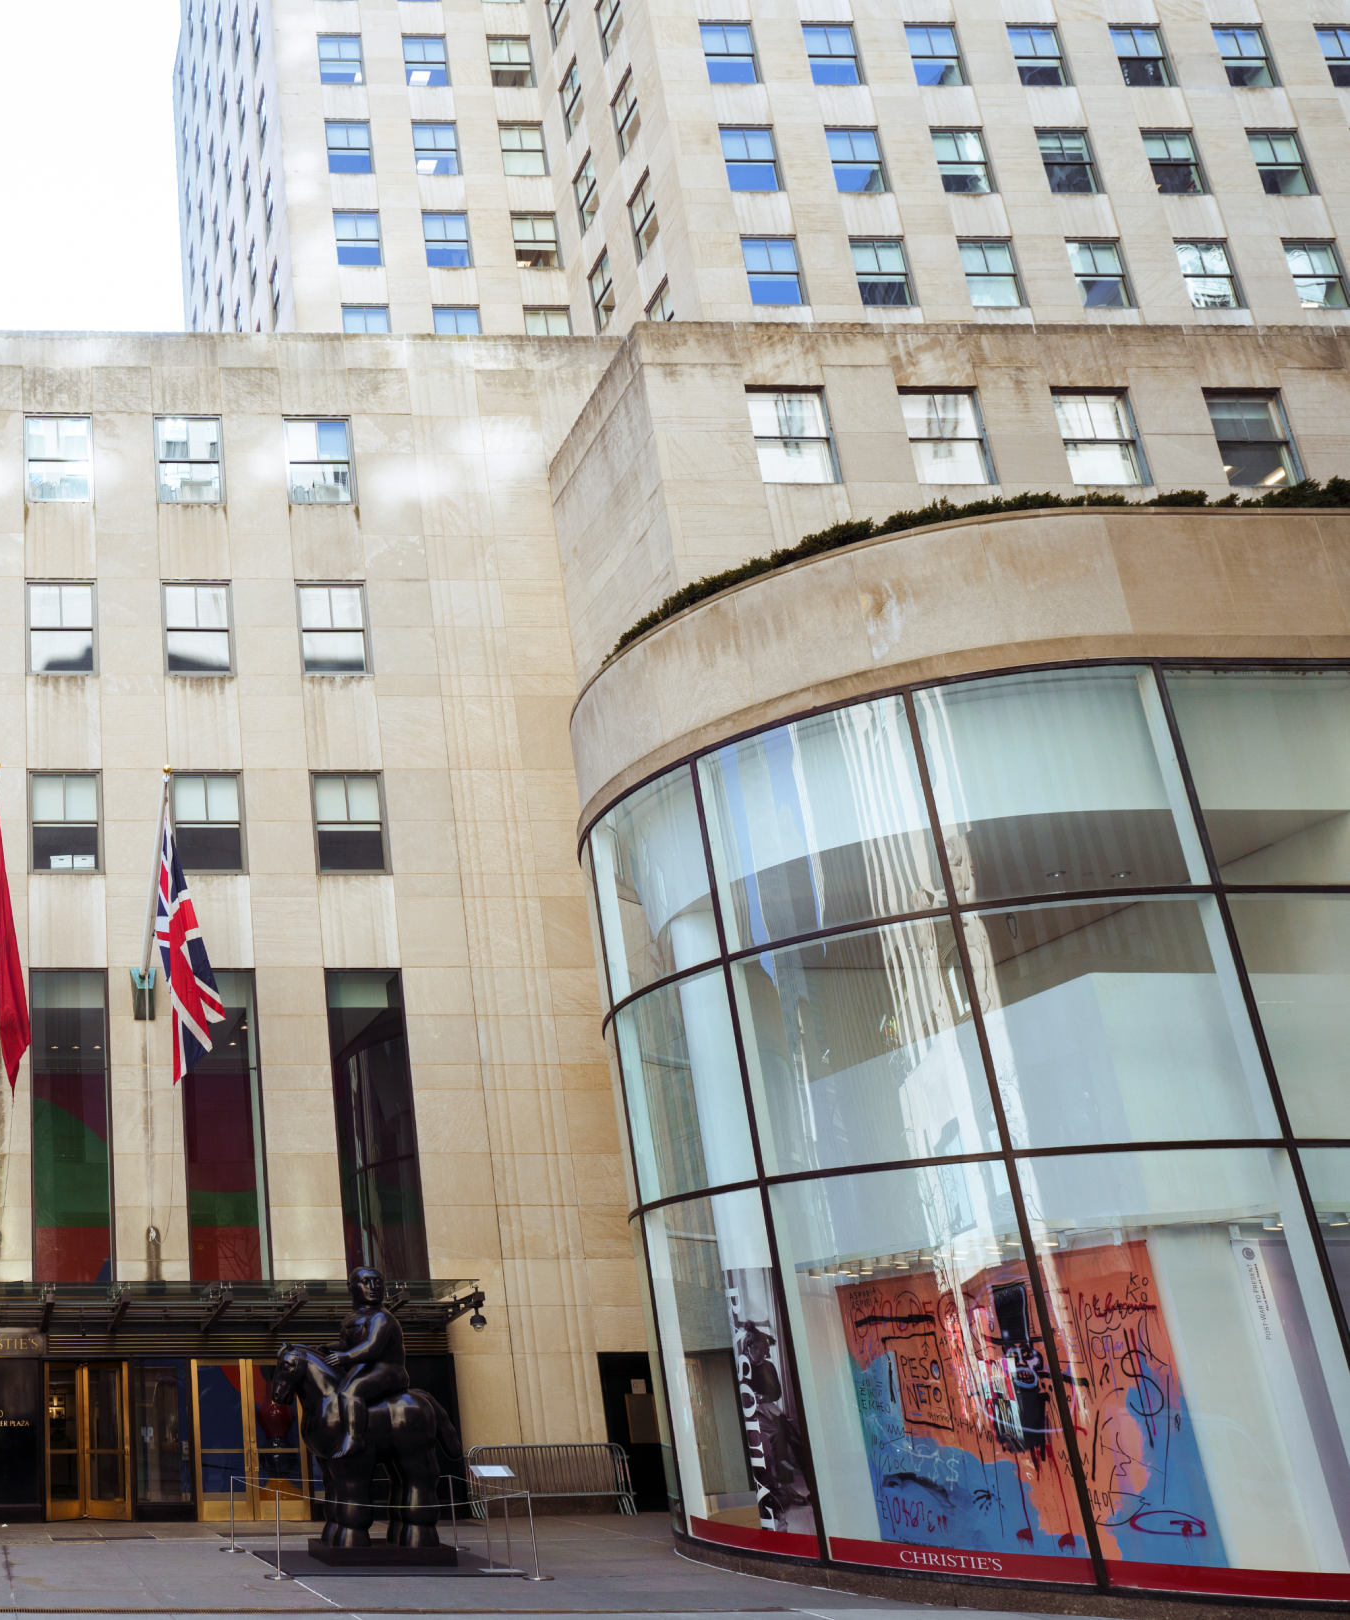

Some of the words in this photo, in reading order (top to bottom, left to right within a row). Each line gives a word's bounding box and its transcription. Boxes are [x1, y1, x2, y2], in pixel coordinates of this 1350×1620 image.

[1246, 1263, 1259, 1294] PRESENT
[900, 1355, 941, 1380] PESO
[906, 1383, 942, 1411] NETO
[899, 1550, 1003, 1572] CHRISTIE'S
